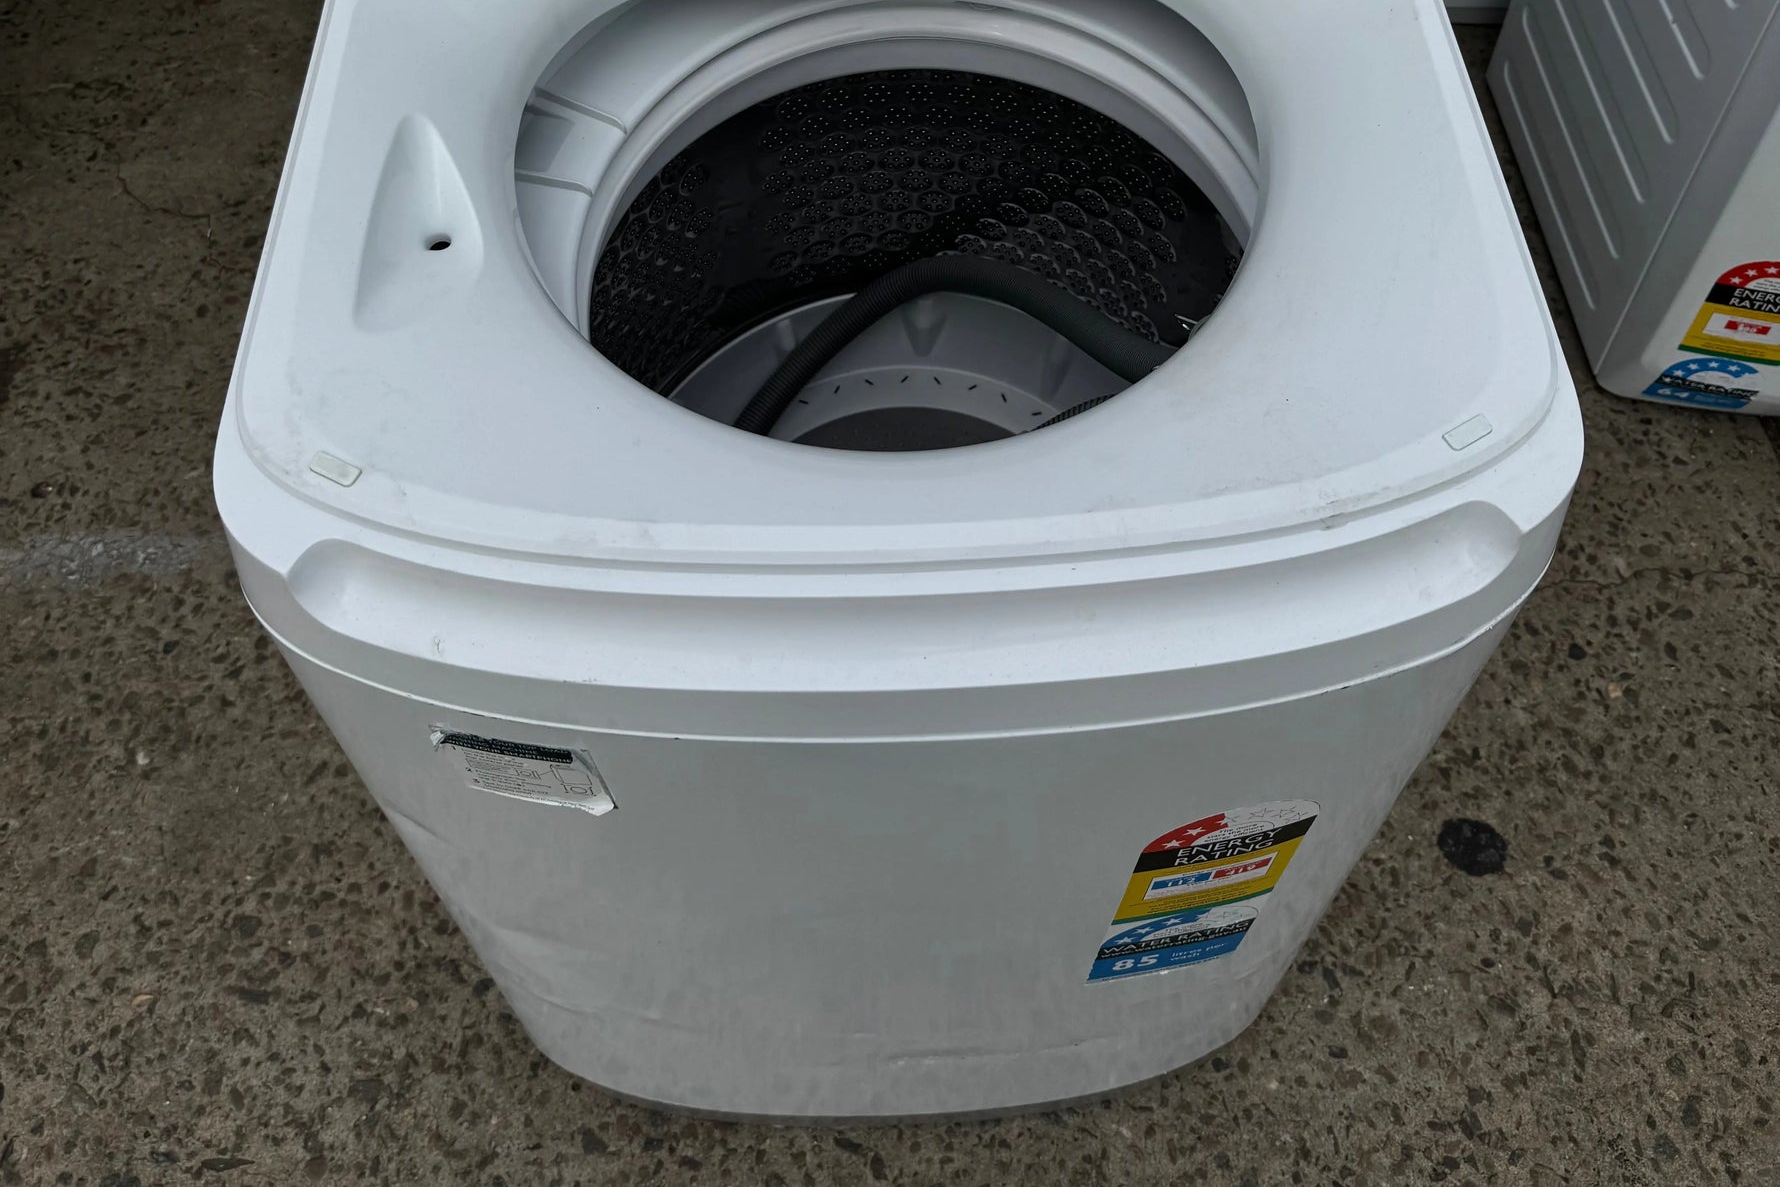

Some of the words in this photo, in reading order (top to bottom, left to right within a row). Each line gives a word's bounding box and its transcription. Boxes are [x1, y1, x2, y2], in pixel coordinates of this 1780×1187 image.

[1174, 839, 1274, 866] RATING
[1177, 828, 1282, 857] ENERGY
[1104, 936, 1171, 955] WATER
[1178, 920, 1250, 943] RATING
[1112, 954, 1160, 971] 85
